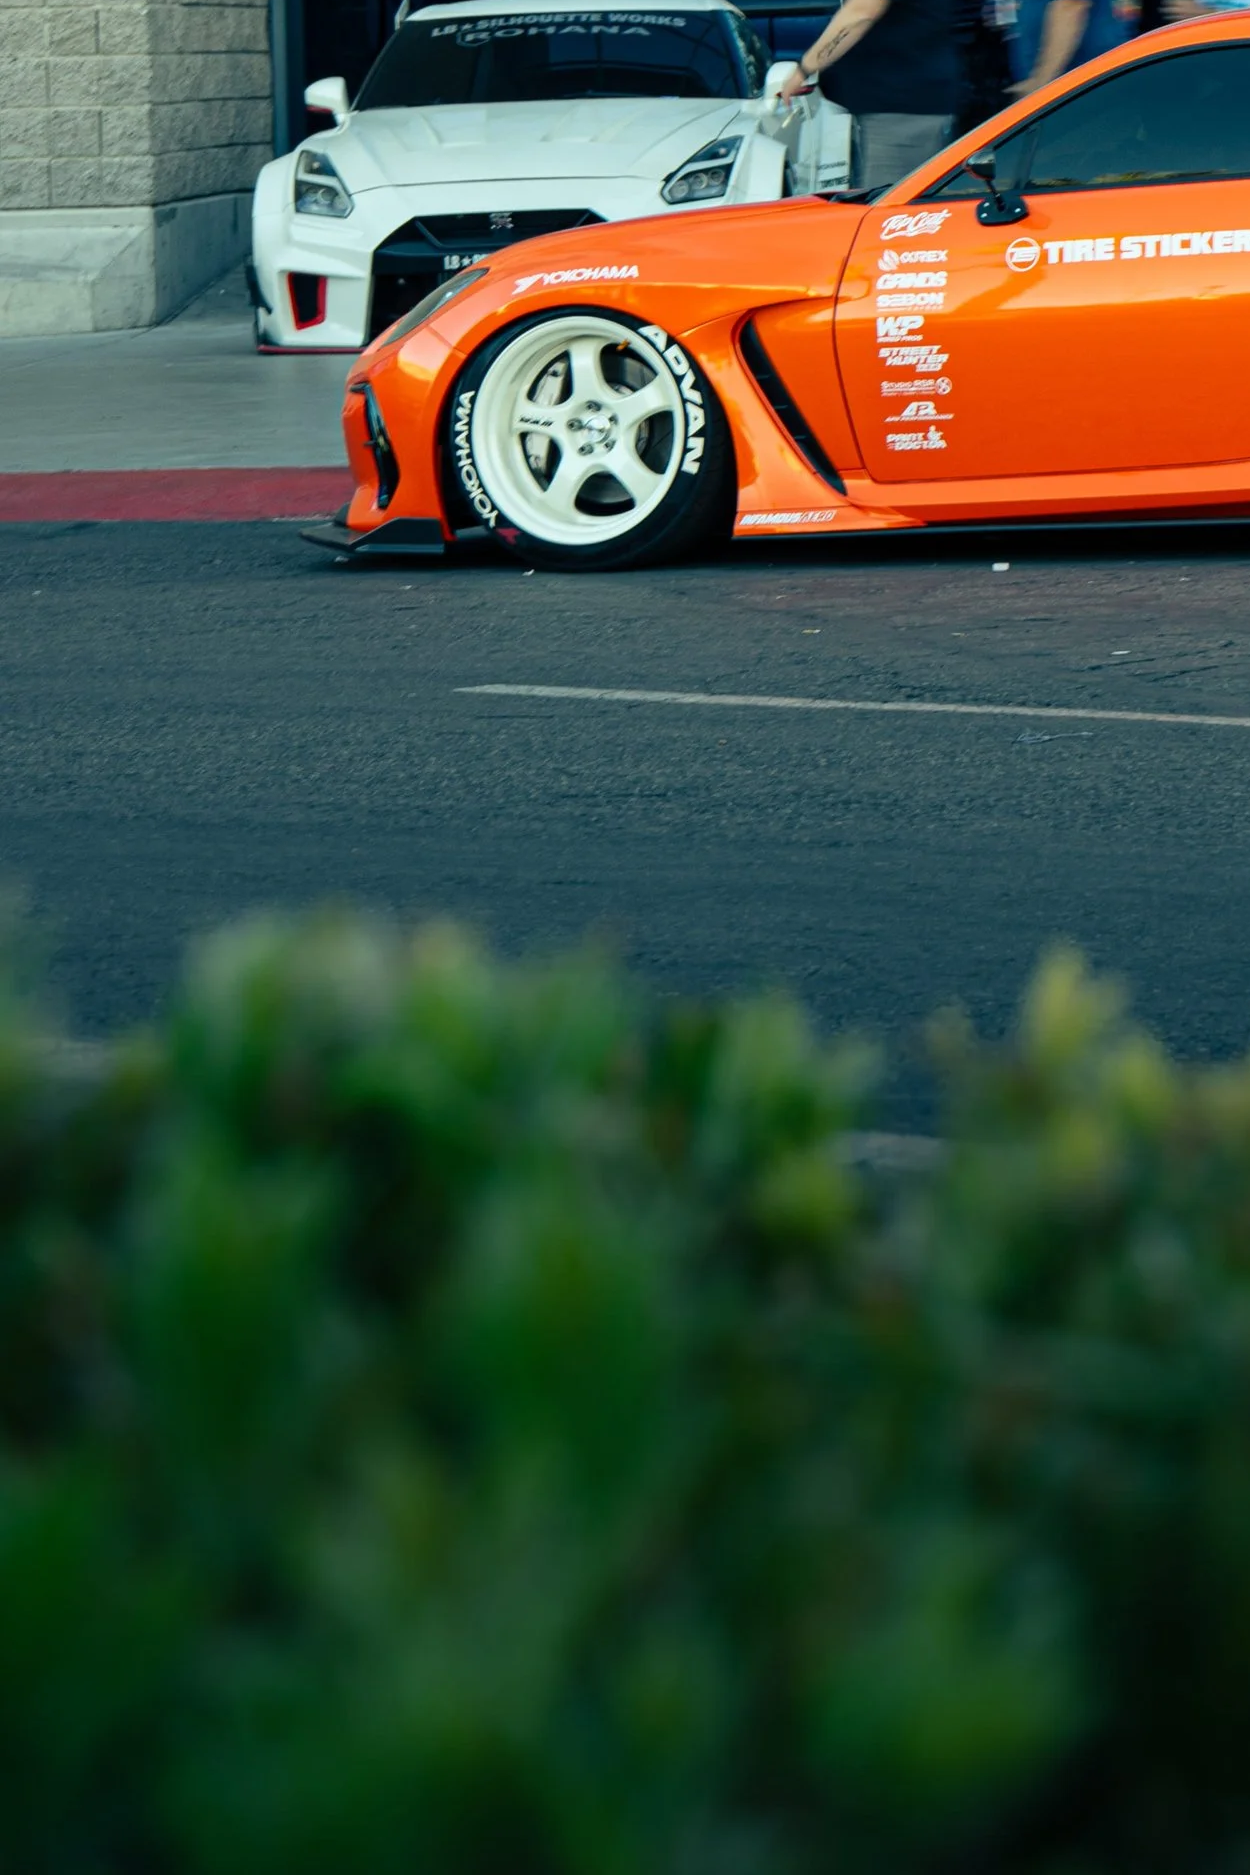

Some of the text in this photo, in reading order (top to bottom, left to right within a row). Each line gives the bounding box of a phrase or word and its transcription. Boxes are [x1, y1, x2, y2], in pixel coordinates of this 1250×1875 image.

[476, 13, 602, 31] SILHOUETTE
[608, 12, 687, 27] WORKS
[464, 25, 651, 42] ROHANA
[1043, 237, 1115, 264] TIRE
[543, 265, 640, 286] YOKOHAMA
[878, 345, 942, 357] STREET
[637, 324, 706, 475] ADVAN
[454, 390, 499, 529] YOKOHAMA
